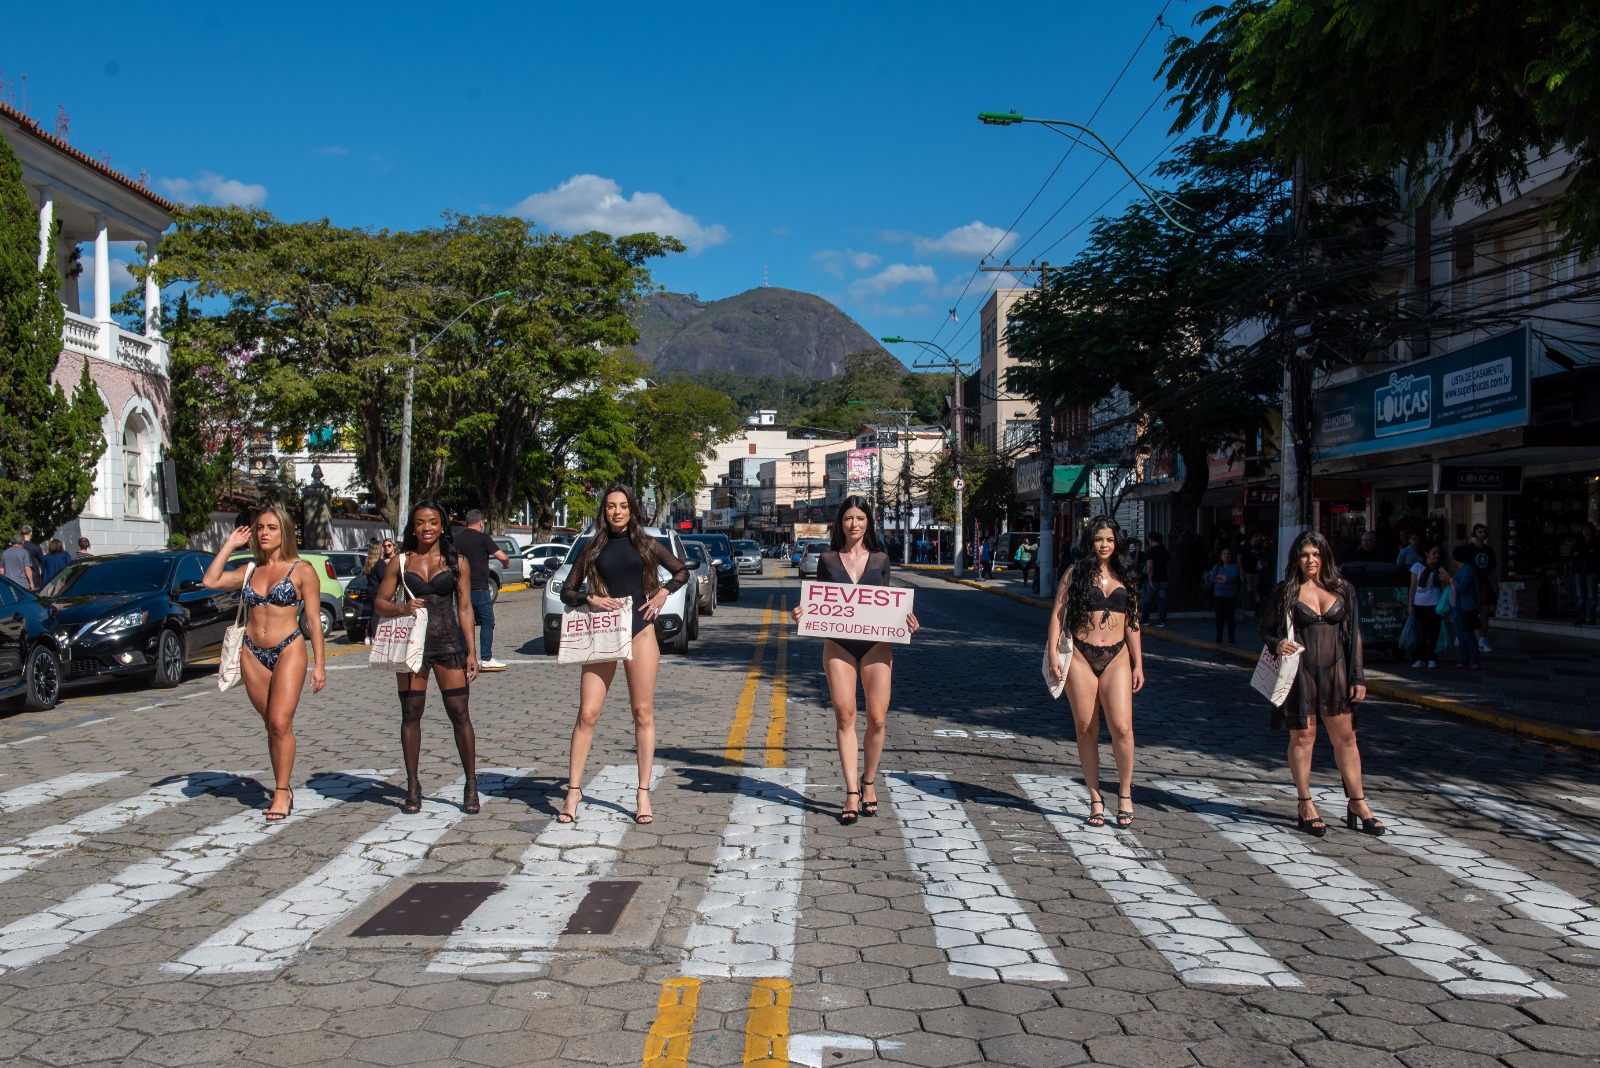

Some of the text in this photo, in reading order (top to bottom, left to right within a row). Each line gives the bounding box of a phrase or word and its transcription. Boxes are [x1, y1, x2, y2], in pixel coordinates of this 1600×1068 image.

[1452, 364, 1504, 387] LISTA DE CASAMENTO
[1377, 390, 1429, 422] LOUÇAS
[808, 585, 907, 608] FEVEST
[808, 603, 855, 617] 2023
[567, 615, 621, 633] FEVEST
[805, 620, 906, 638] #ESTOUDENTRO
